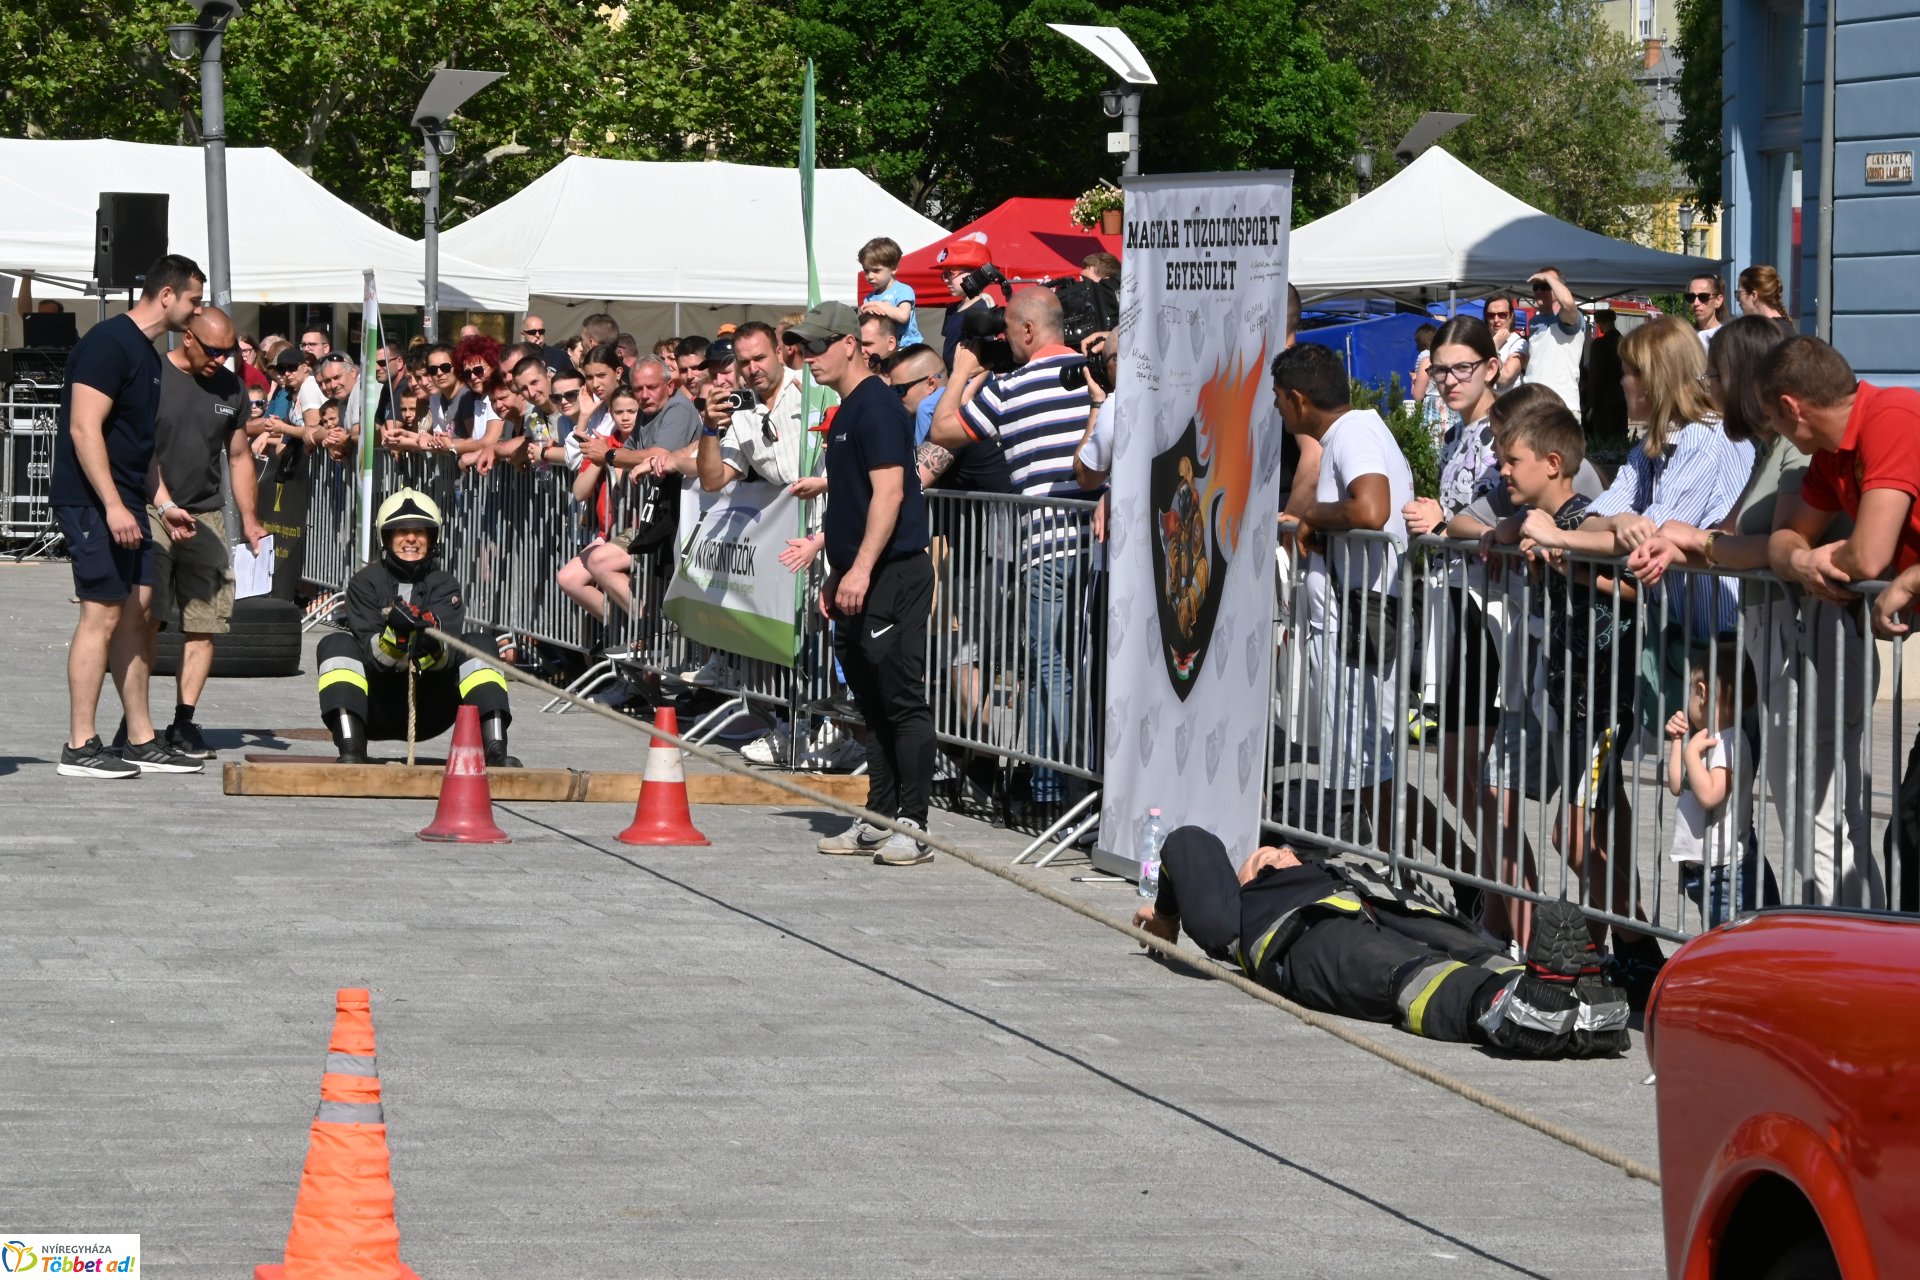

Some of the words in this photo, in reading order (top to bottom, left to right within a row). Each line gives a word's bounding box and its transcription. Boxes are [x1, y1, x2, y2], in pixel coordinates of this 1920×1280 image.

[1126, 219, 1180, 249] MAGYAR
[1183, 204, 1281, 248] TŰZOLTÓSPORT
[1166, 251, 1237, 291] EGYESÜLET
